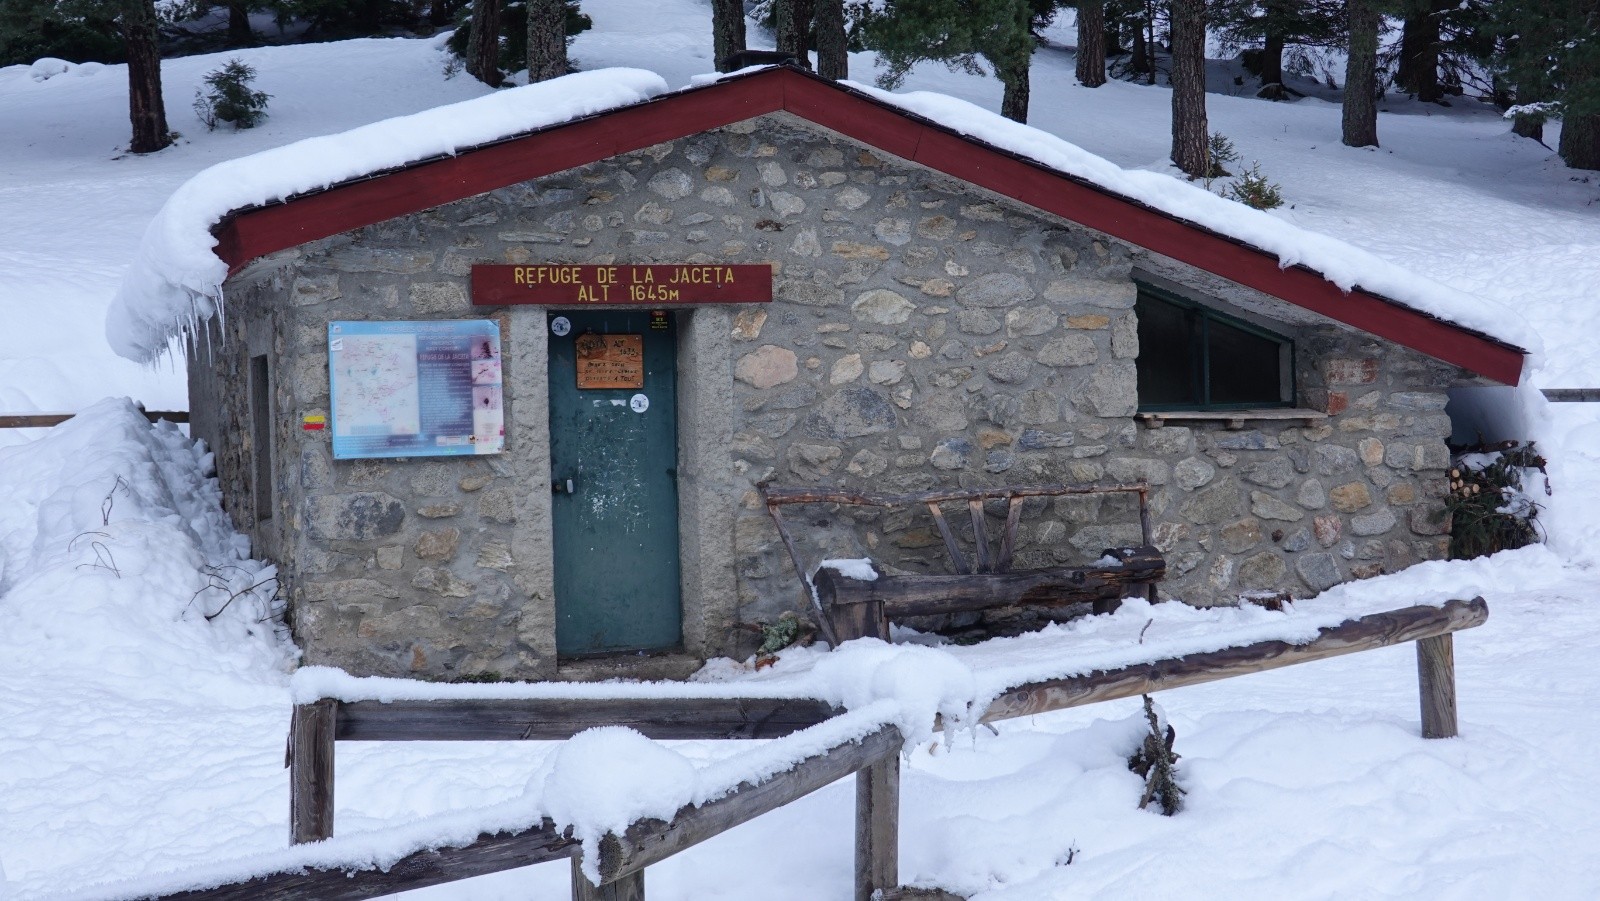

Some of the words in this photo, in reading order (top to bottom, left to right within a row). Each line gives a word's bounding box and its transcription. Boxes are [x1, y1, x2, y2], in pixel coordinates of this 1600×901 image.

[515, 268, 581, 283] REFUGE
[598, 268, 617, 283] DE
[633, 268, 653, 283] LA
[670, 268, 733, 283] JACETA
[579, 286, 609, 301] ALT
